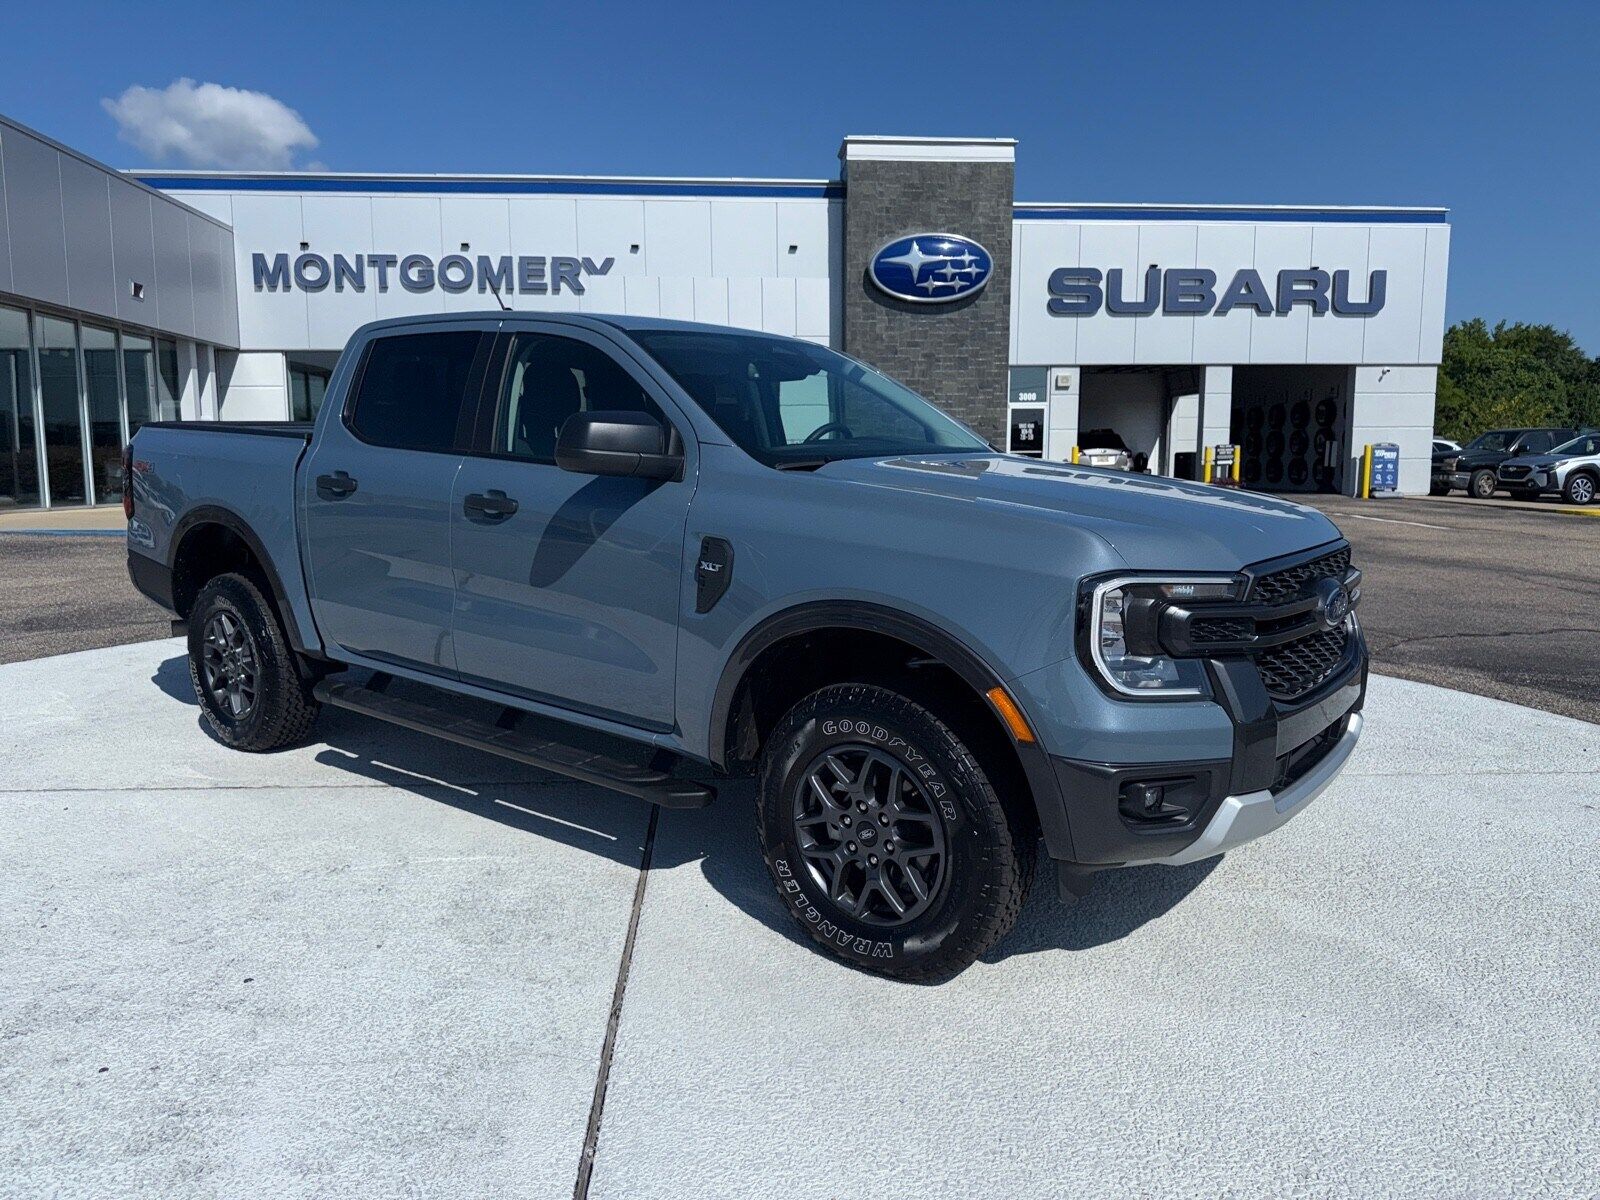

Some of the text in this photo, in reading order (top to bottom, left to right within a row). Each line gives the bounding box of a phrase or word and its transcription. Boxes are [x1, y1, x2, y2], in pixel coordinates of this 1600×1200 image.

[1047, 267, 1388, 317] SUBARU
[700, 560, 724, 572] XLT
[822, 719, 956, 821] GOODYEAR
[775, 859, 894, 958] WRANGLER
